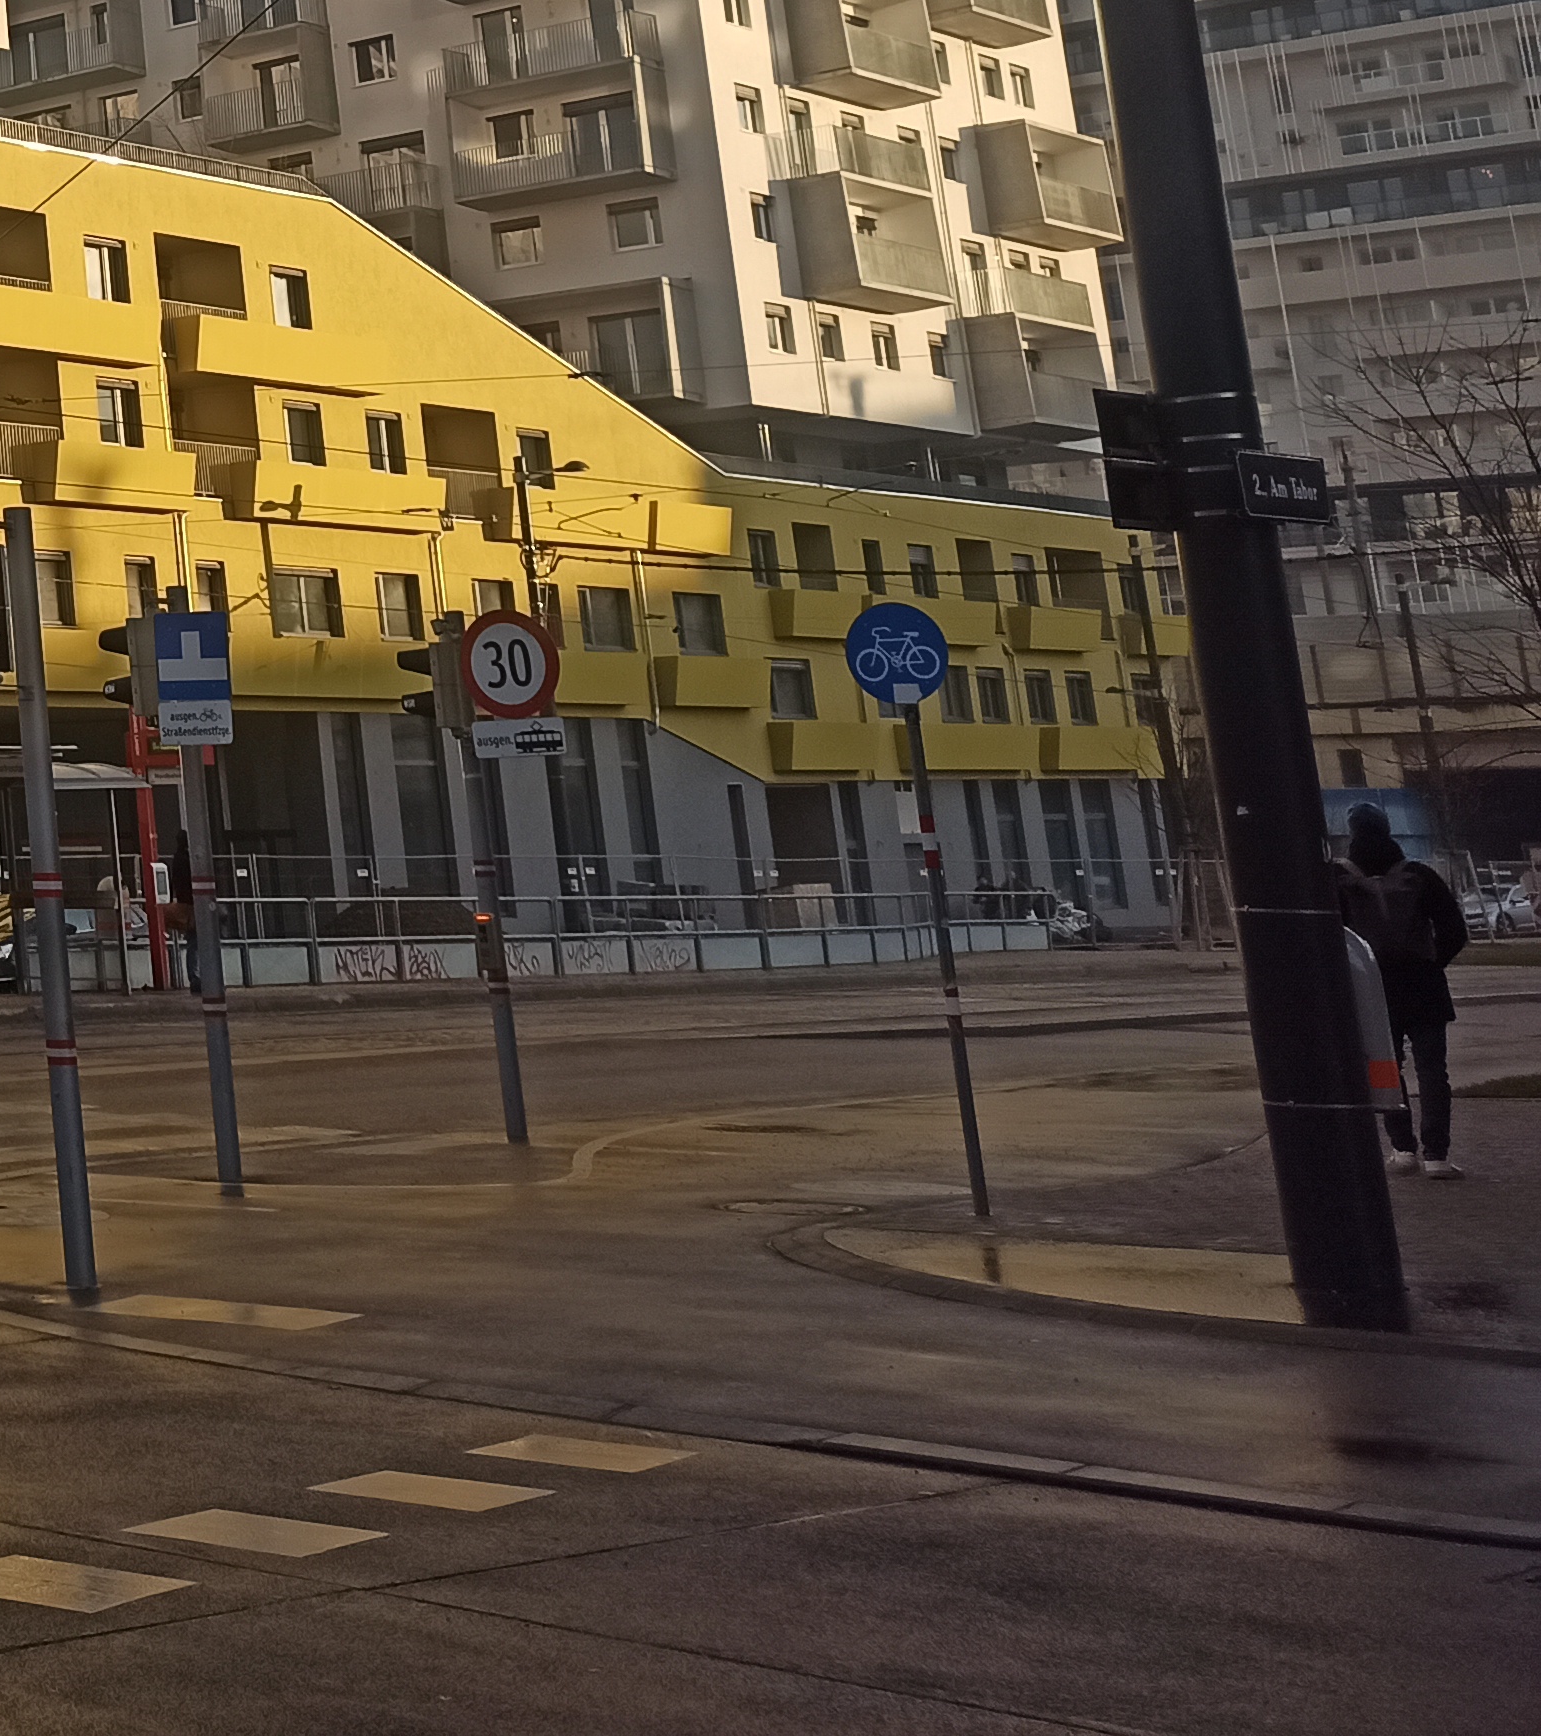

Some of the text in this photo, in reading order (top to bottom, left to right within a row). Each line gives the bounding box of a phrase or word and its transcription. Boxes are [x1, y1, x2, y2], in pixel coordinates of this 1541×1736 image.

[1269, 475, 1289, 499] Am
[1288, 476, 1318, 502] Tabor
[482, 639, 532, 689] 30
[170, 712, 201, 724] ausgen.
[476, 736, 514, 749] ausgen.
